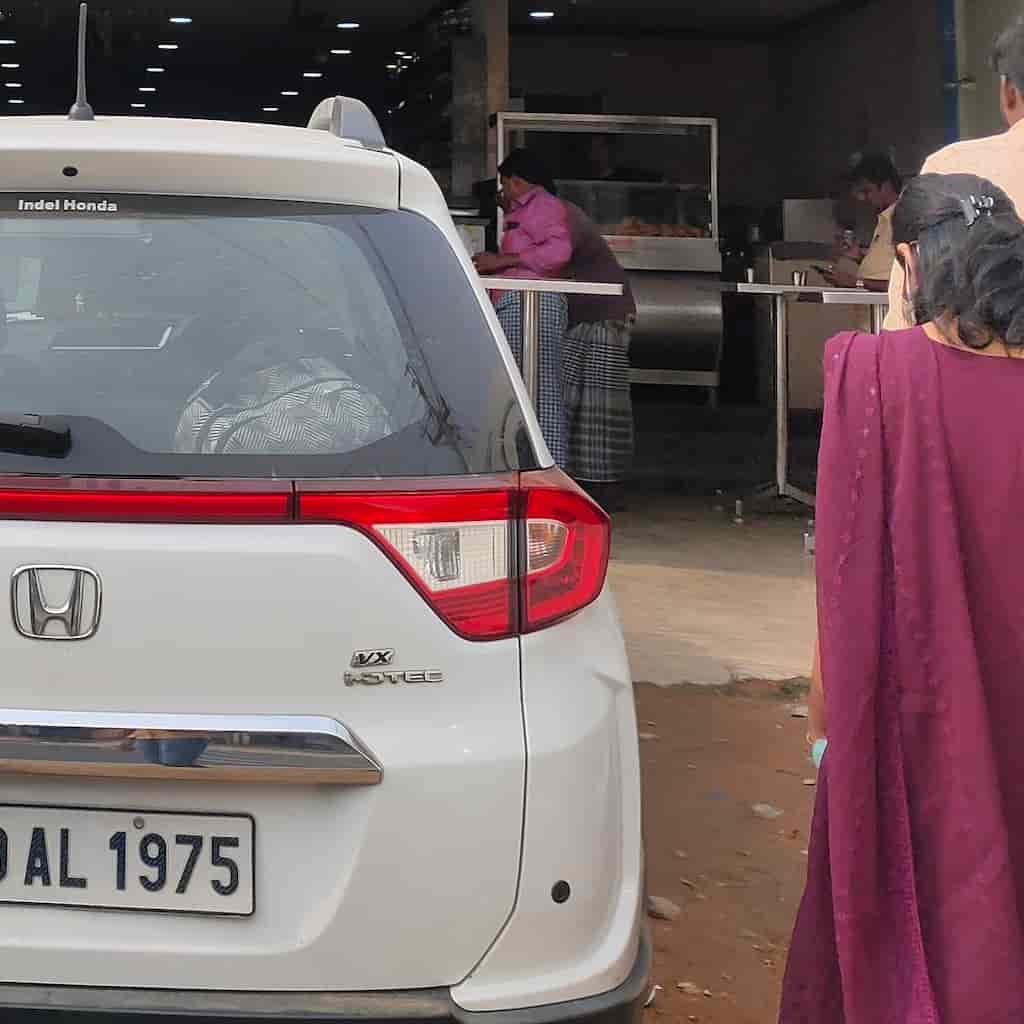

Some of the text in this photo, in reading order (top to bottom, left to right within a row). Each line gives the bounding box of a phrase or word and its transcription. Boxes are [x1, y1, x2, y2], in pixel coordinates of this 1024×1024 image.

[18, 199, 118, 212] Indel Honda
[353, 650, 394, 667] VX
[23, 826, 88, 889] AL
[109, 831, 240, 897] 1975
